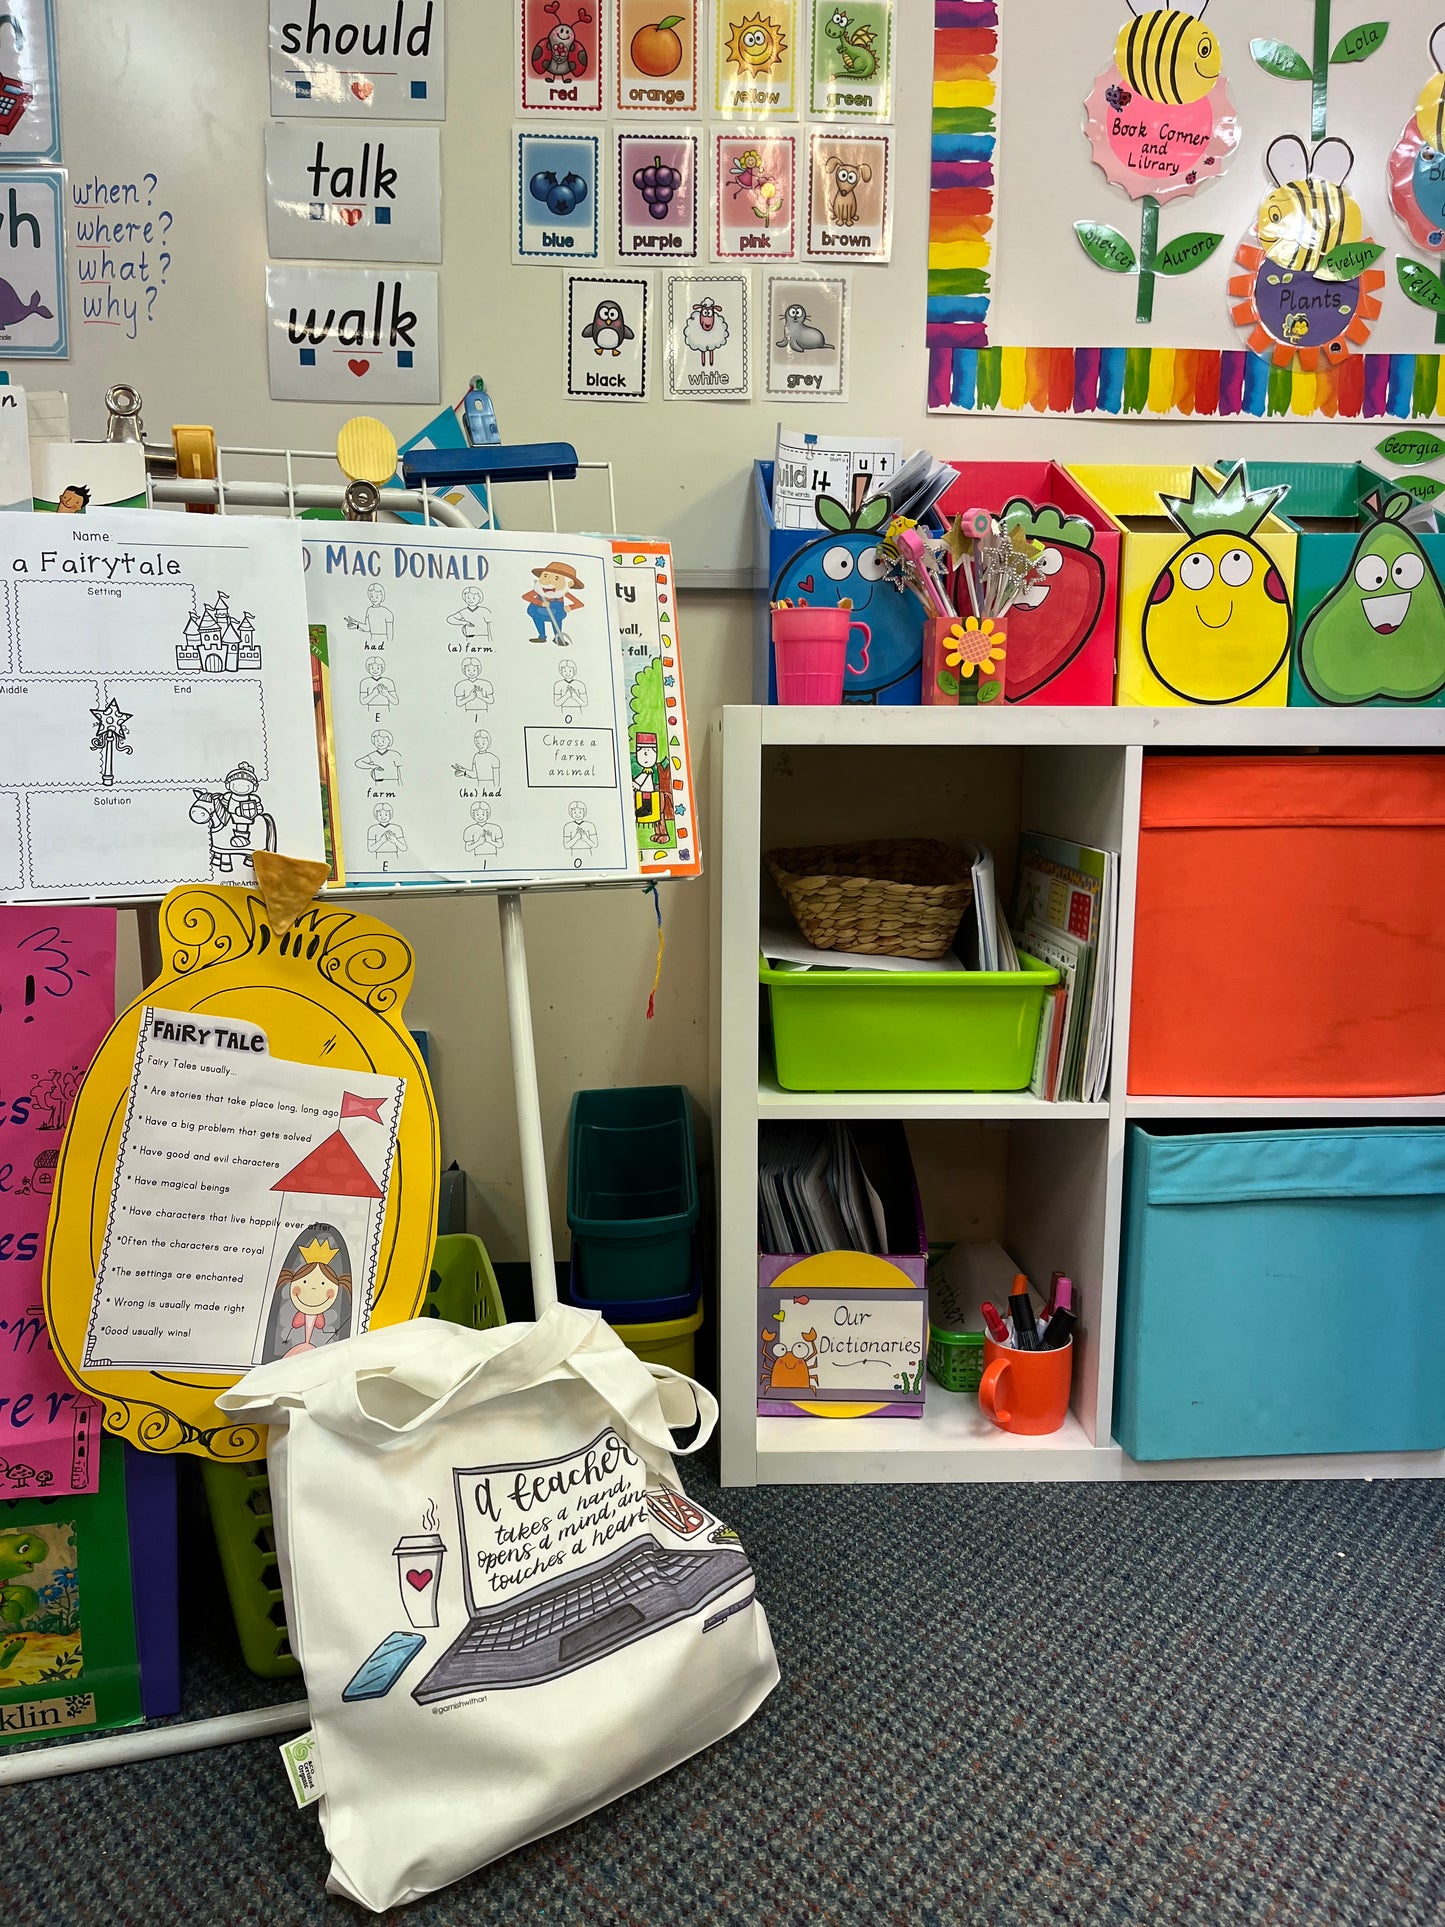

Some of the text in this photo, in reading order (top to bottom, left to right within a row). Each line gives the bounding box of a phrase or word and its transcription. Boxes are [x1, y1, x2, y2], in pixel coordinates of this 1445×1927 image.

[280, 0, 434, 57] should
[1344, 27, 1380, 56] Lola
[550, 86, 577, 101] red
[629, 88, 685, 104] orange
[729, 88, 780, 107] yellow
[826, 92, 873, 109] green
[1112, 117, 1210, 146] Book Corner
[1141, 141, 1168, 155] and
[307, 141, 397, 199] talk
[1127, 152, 1180, 176] Library
[73, 173, 158, 207] when?
[76, 211, 174, 247] where?
[542, 232, 574, 249] blue
[633, 233, 682, 251] purple
[740, 232, 771, 251] pink
[821, 231, 871, 248] brown
[1161, 236, 1216, 270] Aurora
[1327, 249, 1375, 274] Evelyn
[79, 246, 172, 284] what?
[1279, 289, 1342, 311] Plants
[83, 286, 158, 340] why?
[288, 281, 417, 348] walk
[586, 373, 626, 388] black
[688, 371, 729, 387] white
[787, 373, 823, 390] grey
[1384, 437, 1440, 462] Georgia
[859, 459, 868, 470] u
[880, 457, 887, 471] t
[776, 463, 807, 489] uild
[12, 551, 181, 579] a Fairytale
[326, 544, 381, 577] MAC
[394, 547, 489, 581] DONALD
[87, 587, 122, 598] Setting
[364, 641, 385, 651] had
[448, 643, 462, 653] (a)
[627, 645, 652, 658] fall,
[174, 686, 192, 694] End
[375, 713, 381, 723] E
[543, 734, 586, 747] Choose
[554, 749, 587, 762] farm
[548, 765, 596, 777] animal
[93, 797, 132, 806] Solution
[367, 788, 396, 798] farm
[459, 788, 502, 798] (he) had
[382, 861, 389, 871] E
[147, 1055, 169, 1069] Fairy
[174, 1059, 197, 1071] Tales
[151, 1086, 167, 1097] Are
[170, 1090, 202, 1101] stories
[205, 1093, 224, 1104] that
[227, 1095, 247, 1106] take
[249, 1099, 274, 1112] place
[301, 1104, 320, 1117] long
[322, 1108, 339, 1119] ago
[145, 1116, 168, 1127] Have
[180, 1120, 195, 1132] big
[198, 1122, 235, 1136] problem
[239, 1126, 257, 1137] that
[260, 1129, 280, 1140] gets
[283, 1131, 313, 1143] solved
[139, 1145, 280, 1169] Have good and evil characters
[134, 1175, 230, 1194] Have magical beings
[129, 1205, 152, 1217] Have
[155, 1209, 206, 1221] characters
[209, 1212, 228, 1222] that
[230, 1214, 246, 1224] live
[249, 1216, 281, 1229] happily
[284, 1221, 304, 1229] ever
[121, 1235, 265, 1256] Often the characters are royal
[115, 1267, 244, 1283] The settings are enchanted
[114, 1297, 245, 1315] Wrong is usually made right
[833, 1305, 872, 1327] Our
[104, 1326, 192, 1338] Good usually wins!
[819, 1336, 921, 1354] Dictionaries
[475, 1436, 639, 1522] a teacher
[494, 1474, 631, 1545] takes a hand,
[477, 1542, 536, 1574] opens
[539, 1534, 553, 1550] a
[558, 1503, 616, 1541] mind,
[488, 1505, 648, 1592] touches a heart
